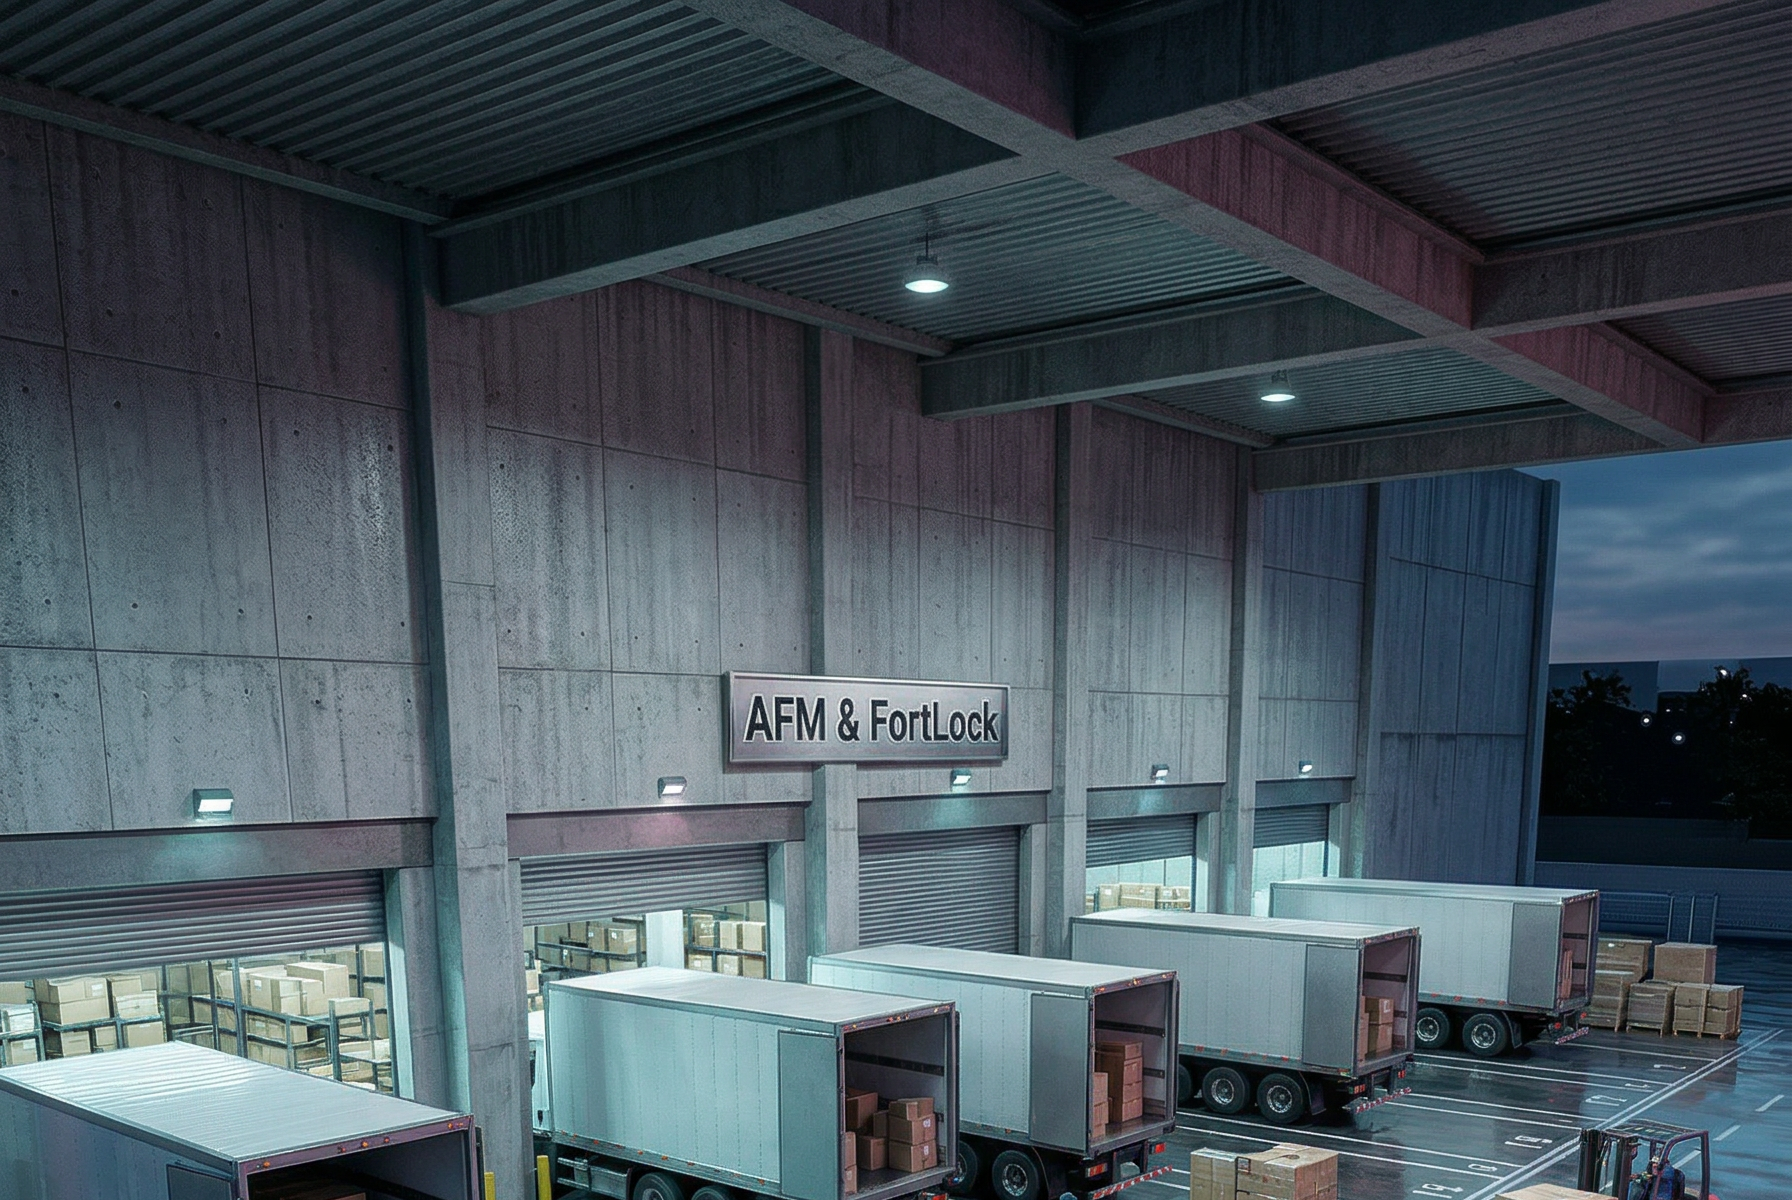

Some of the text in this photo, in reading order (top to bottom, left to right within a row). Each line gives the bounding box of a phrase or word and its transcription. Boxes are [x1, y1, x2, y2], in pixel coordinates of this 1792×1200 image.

[744, 695, 1000, 742] AFM & FortLock
